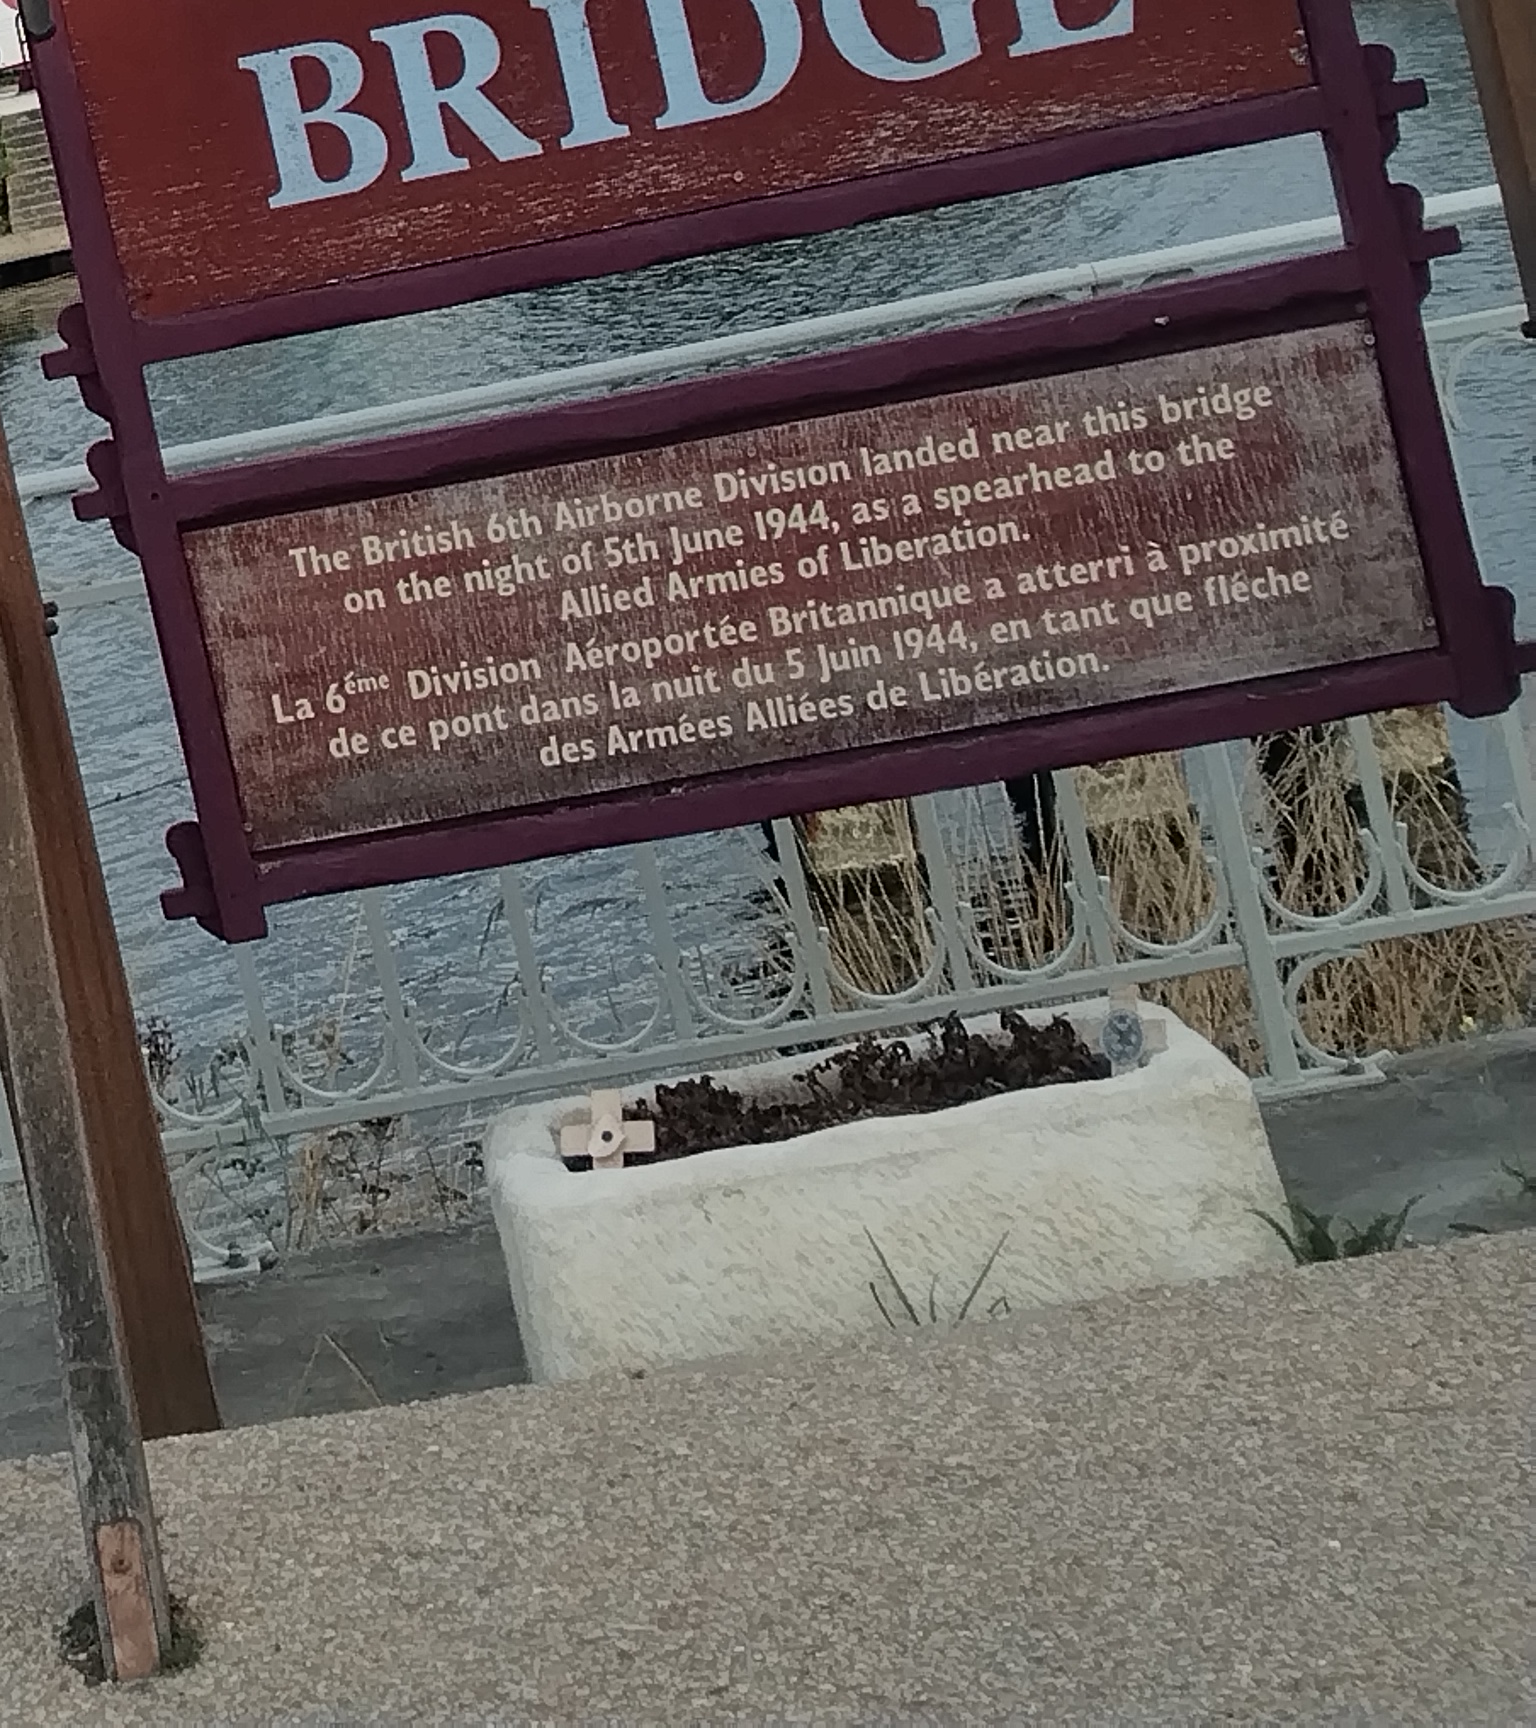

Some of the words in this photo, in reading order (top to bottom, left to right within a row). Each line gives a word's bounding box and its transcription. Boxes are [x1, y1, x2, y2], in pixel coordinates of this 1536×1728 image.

[289, 546, 351, 578] The
[361, 521, 476, 566] British
[486, 508, 543, 544] 6th
[554, 485, 703, 532] Airborne
[714, 460, 852, 503] Division
[860, 429, 979, 477] landed
[992, 420, 1071, 454] near
[1082, 400, 1148, 437] this
[1158, 383, 1273, 424] bridge
[344, 587, 386, 614] on
[396, 572, 452, 605] the
[464, 552, 551, 597] night
[561, 540, 593, 575] of
[604, 531, 659, 569] 5th
[669, 524, 744, 566] June
[754, 500, 840, 541] 1944,
[852, 498, 890, 525] as
[902, 493, 922, 517] a
[933, 449, 1116, 516] spearhead
[1128, 448, 1165, 475] to
[1177, 434, 1237, 467] the
[272, 693, 315, 724] La
[408, 656, 541, 700] Division
[565, 615, 757, 673] Aéroportée
[767, 582, 971, 637] Britannique
[986, 577, 1006, 600] a
[1017, 545, 1134, 594] atterri
[1147, 541, 1168, 572] à
[1178, 511, 1349, 576] proximité
[561, 576, 655, 621] Allied
[668, 558, 785, 602] Armies
[798, 544, 829, 579] of
[840, 519, 1031, 572] Liberation.
[329, 727, 369, 758] de
[381, 724, 416, 750] ce
[429, 704, 508, 751] pont
[520, 692, 599, 725] dans
[609, 681, 641, 710] la
[652, 664, 721, 703] nuit
[732, 657, 775, 689] du
[785, 648, 805, 679] 5
[817, 637, 881, 683] Juin
[892, 621, 978, 662] 1944,
[990, 618, 1032, 644] en
[1042, 599, 1120, 635] tant
[1129, 590, 1193, 629] que
[539, 736, 596, 767] des
[607, 713, 732, 756] Armées
[746, 691, 854, 732] Alliées
[867, 680, 908, 710] de
[918, 649, 1110, 702] Libération.
